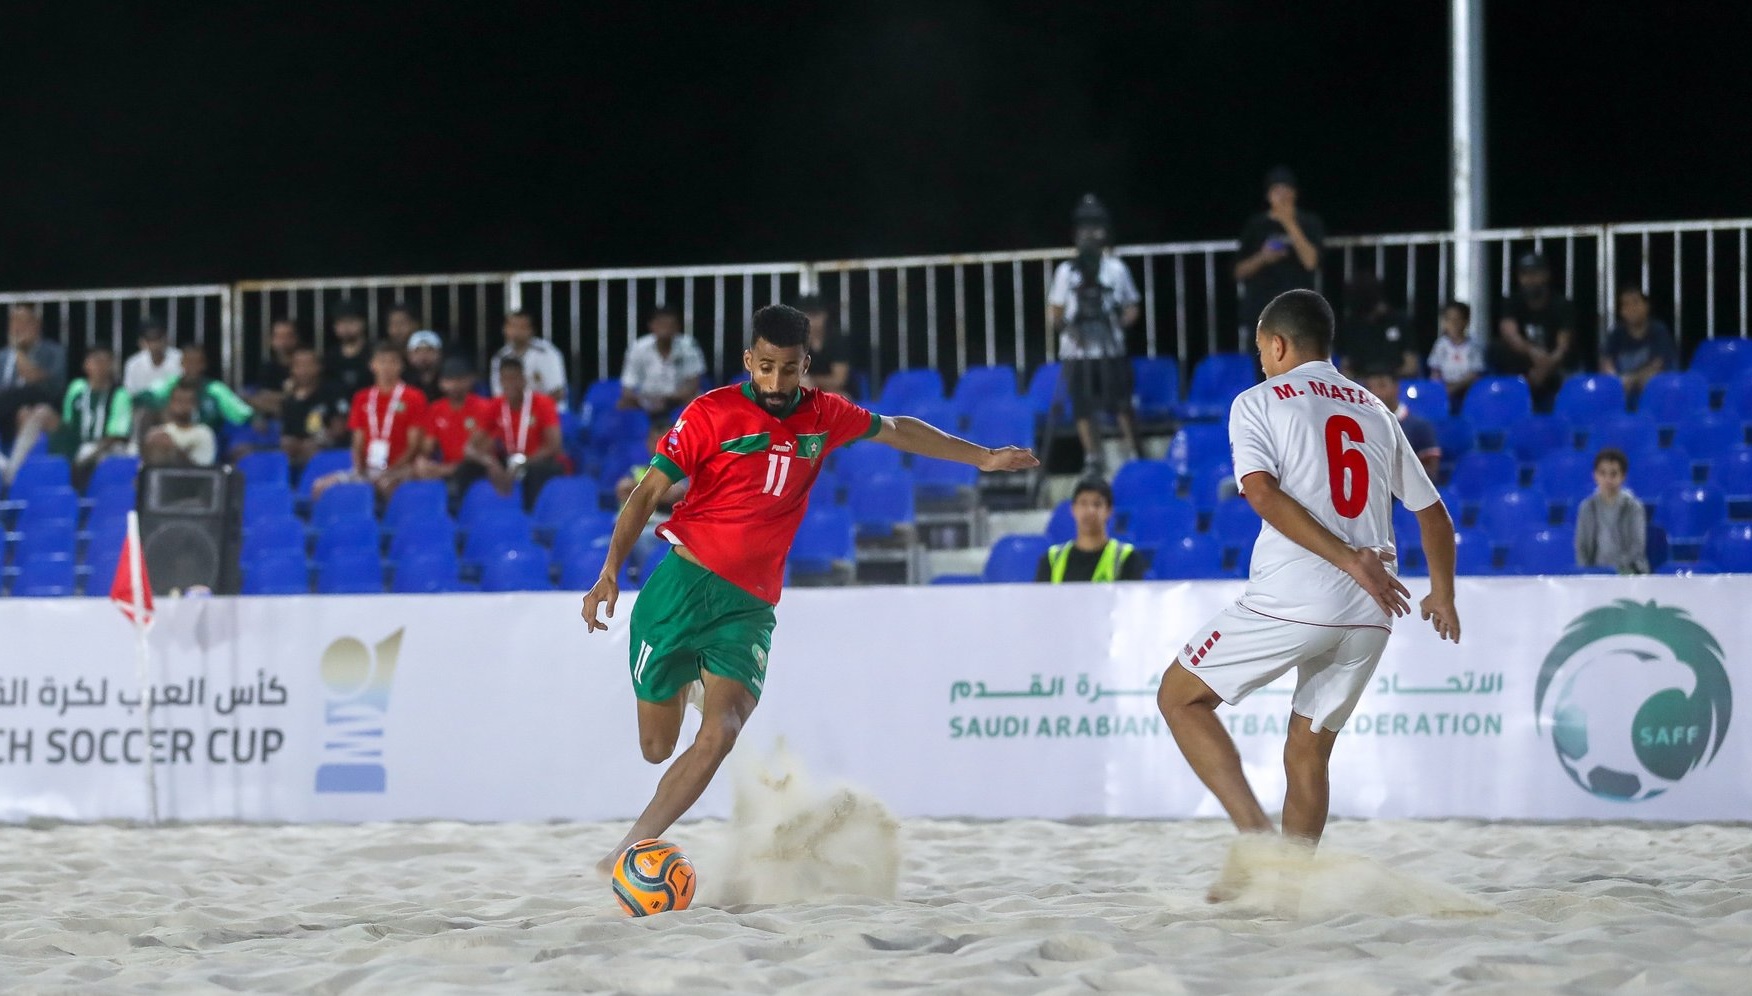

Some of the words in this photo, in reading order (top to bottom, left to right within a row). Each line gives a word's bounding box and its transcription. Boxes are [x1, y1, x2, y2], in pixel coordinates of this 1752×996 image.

[1272, 383, 1305, 400] M.
[1307, 380, 1381, 409] MATA
[762, 453, 791, 497] 11
[1325, 414, 1370, 519] 6
[633, 640, 653, 685] 11
[38, 676, 108, 717] لكرة
[214, 669, 288, 715] كأس
[949, 674, 1064, 703] القدم
[1377, 671, 1503, 695] الاتحاد
[949, 716, 1028, 738] SAUDI
[1036, 715, 1160, 738] ARABIAN
[1341, 712, 1502, 736] DERATION
[1640, 725, 1699, 747] SAFF
[46, 728, 194, 764] SOCCER
[207, 728, 285, 764] CUP
